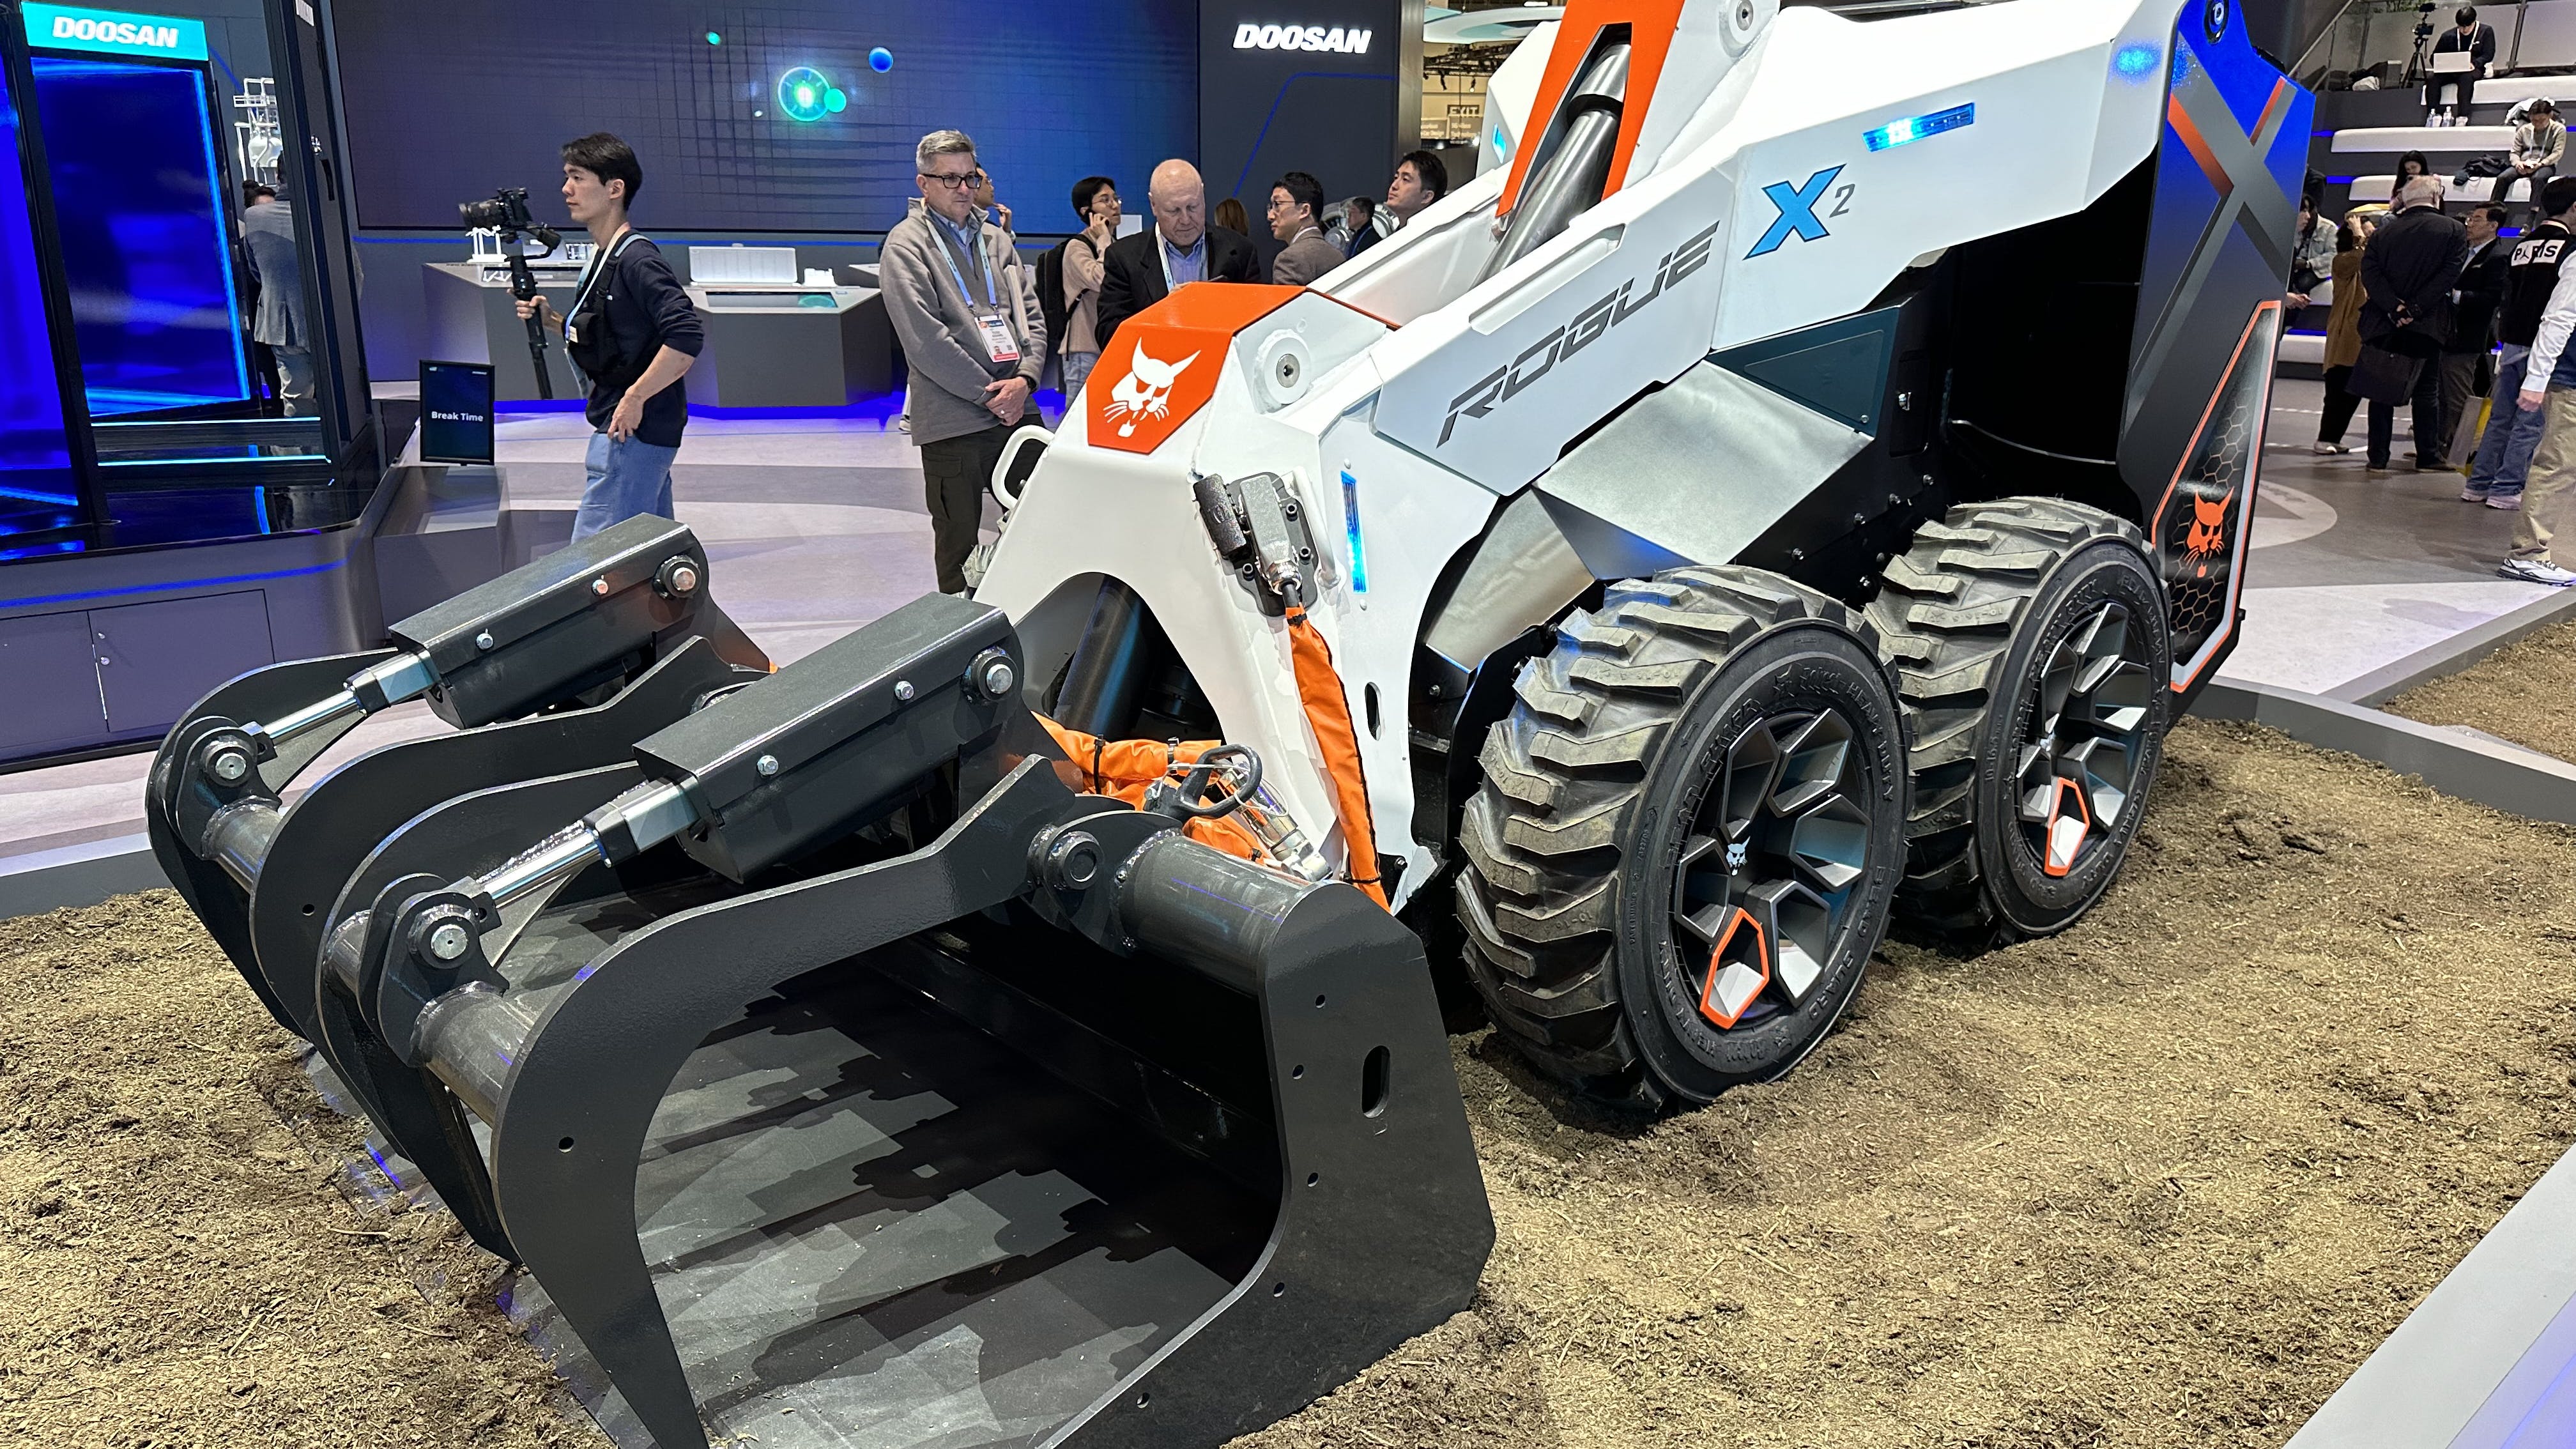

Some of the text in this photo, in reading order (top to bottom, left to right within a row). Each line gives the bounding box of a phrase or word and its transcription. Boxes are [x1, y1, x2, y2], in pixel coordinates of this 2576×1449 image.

[52, 16, 179, 49] DOOSAN
[1232, 23, 1372, 54] DOOSAN
[1450, 106, 1478, 116] EXIT
[1436, 219, 1720, 448] ROGUE
[431, 411, 484, 422] Break Time
[1874, 739, 1896, 804] DUTY
[1807, 866, 1885, 1022] BEAD GUARD
